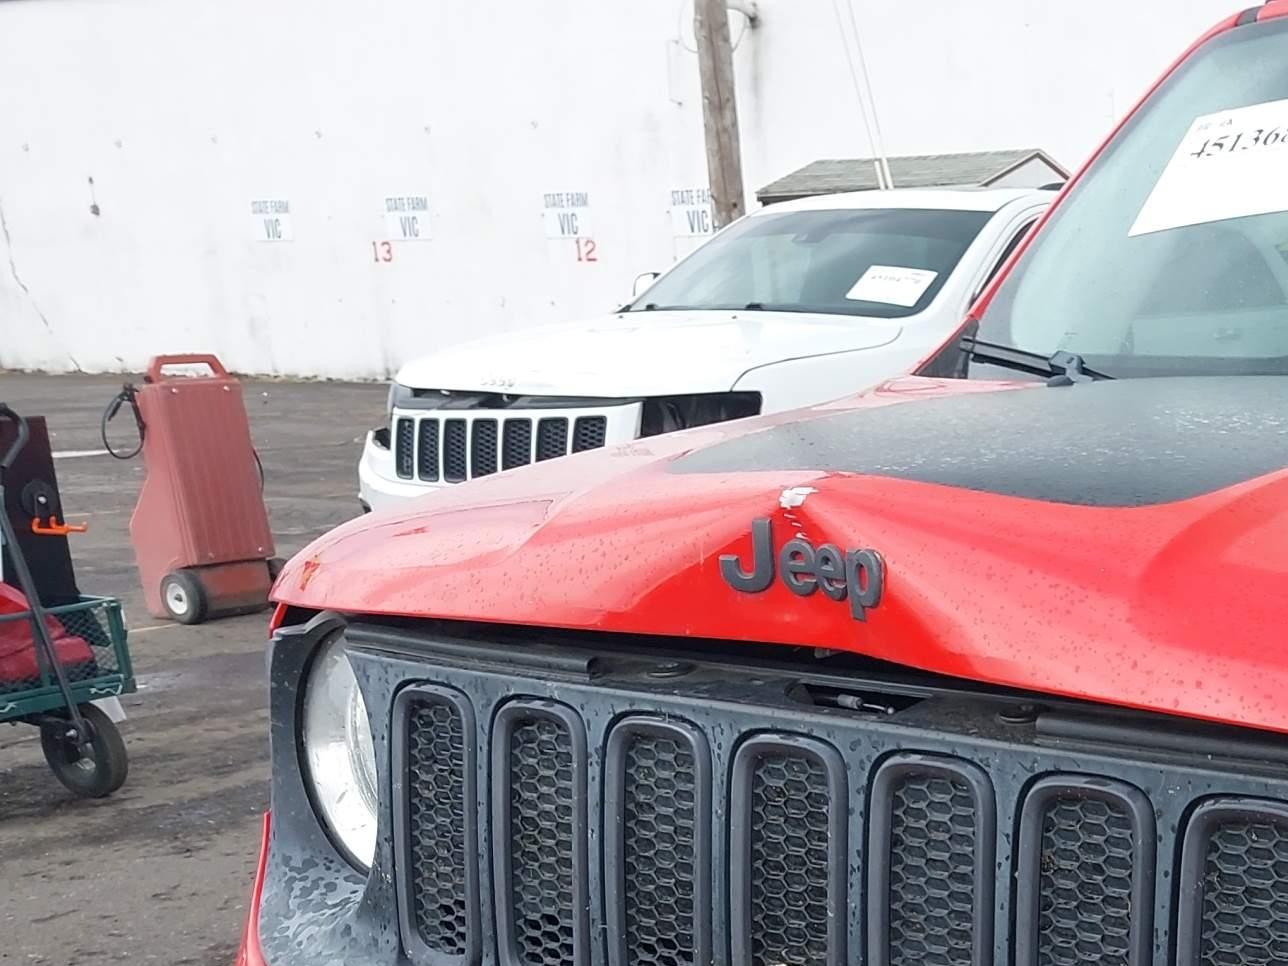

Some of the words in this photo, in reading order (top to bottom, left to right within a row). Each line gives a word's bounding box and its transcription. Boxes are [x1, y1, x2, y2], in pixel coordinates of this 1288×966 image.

[251, 200, 269, 214] STATE
[270, 199, 290, 214] FARM
[385, 196, 406, 212] STATE
[407, 196, 428, 211] FARM
[543, 193, 565, 208] STATE
[566, 191, 589, 208] FARM
[672, 189, 694, 206] STATE
[263, 218, 282, 240] VIC
[399, 215, 420, 238] VIC
[558, 212, 579, 235] VIC
[686, 210, 709, 233] VIC
[372, 240, 393, 263] 13
[575, 237, 598, 262] 12
[718, 517, 886, 622] Jeep
